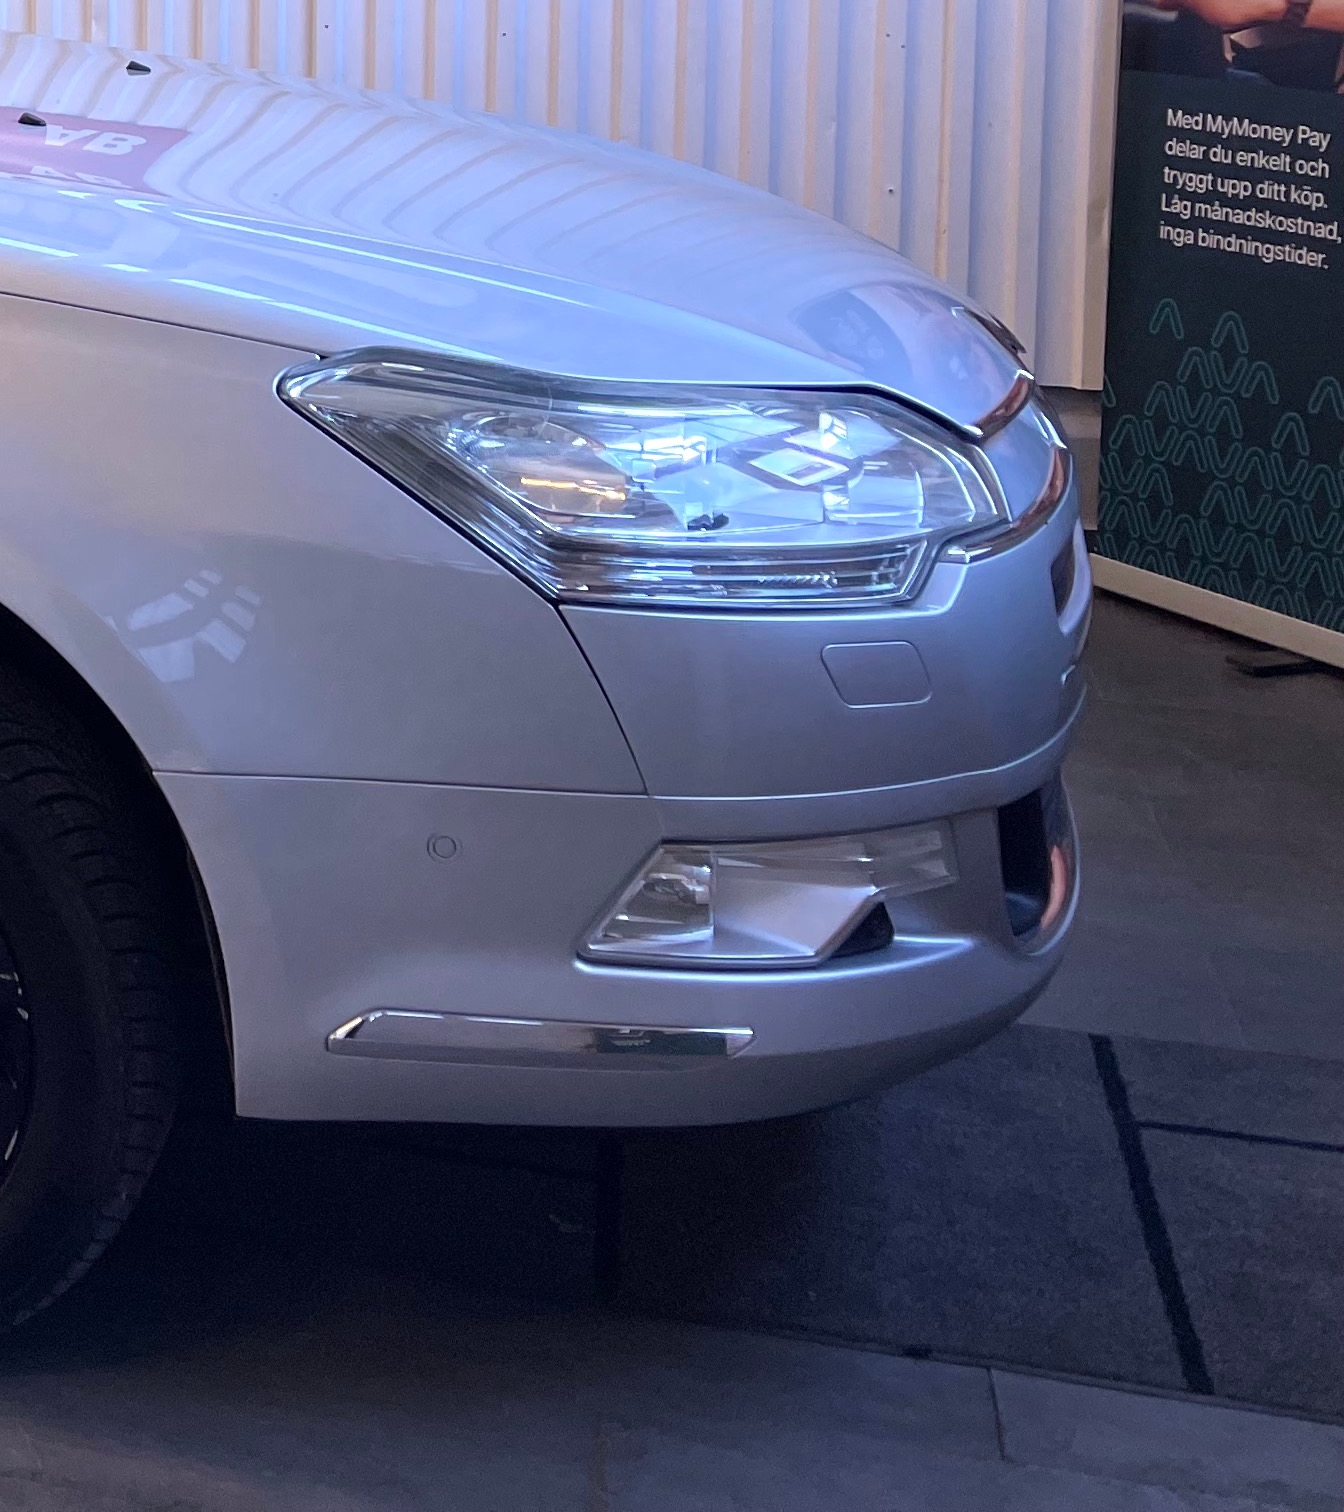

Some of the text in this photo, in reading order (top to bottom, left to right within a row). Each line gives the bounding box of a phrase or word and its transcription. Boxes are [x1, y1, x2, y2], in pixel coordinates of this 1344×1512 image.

[1167, 108, 1331, 152] Med MyMoney Pay
[1165, 138, 1330, 178] delar du enkelt och
[1163, 166, 1329, 211] tryggt upp ditt köp.
[1161, 193, 1343, 244] Låg månadskostnad,
[1159, 221, 1329, 269] inga bindningstider.
